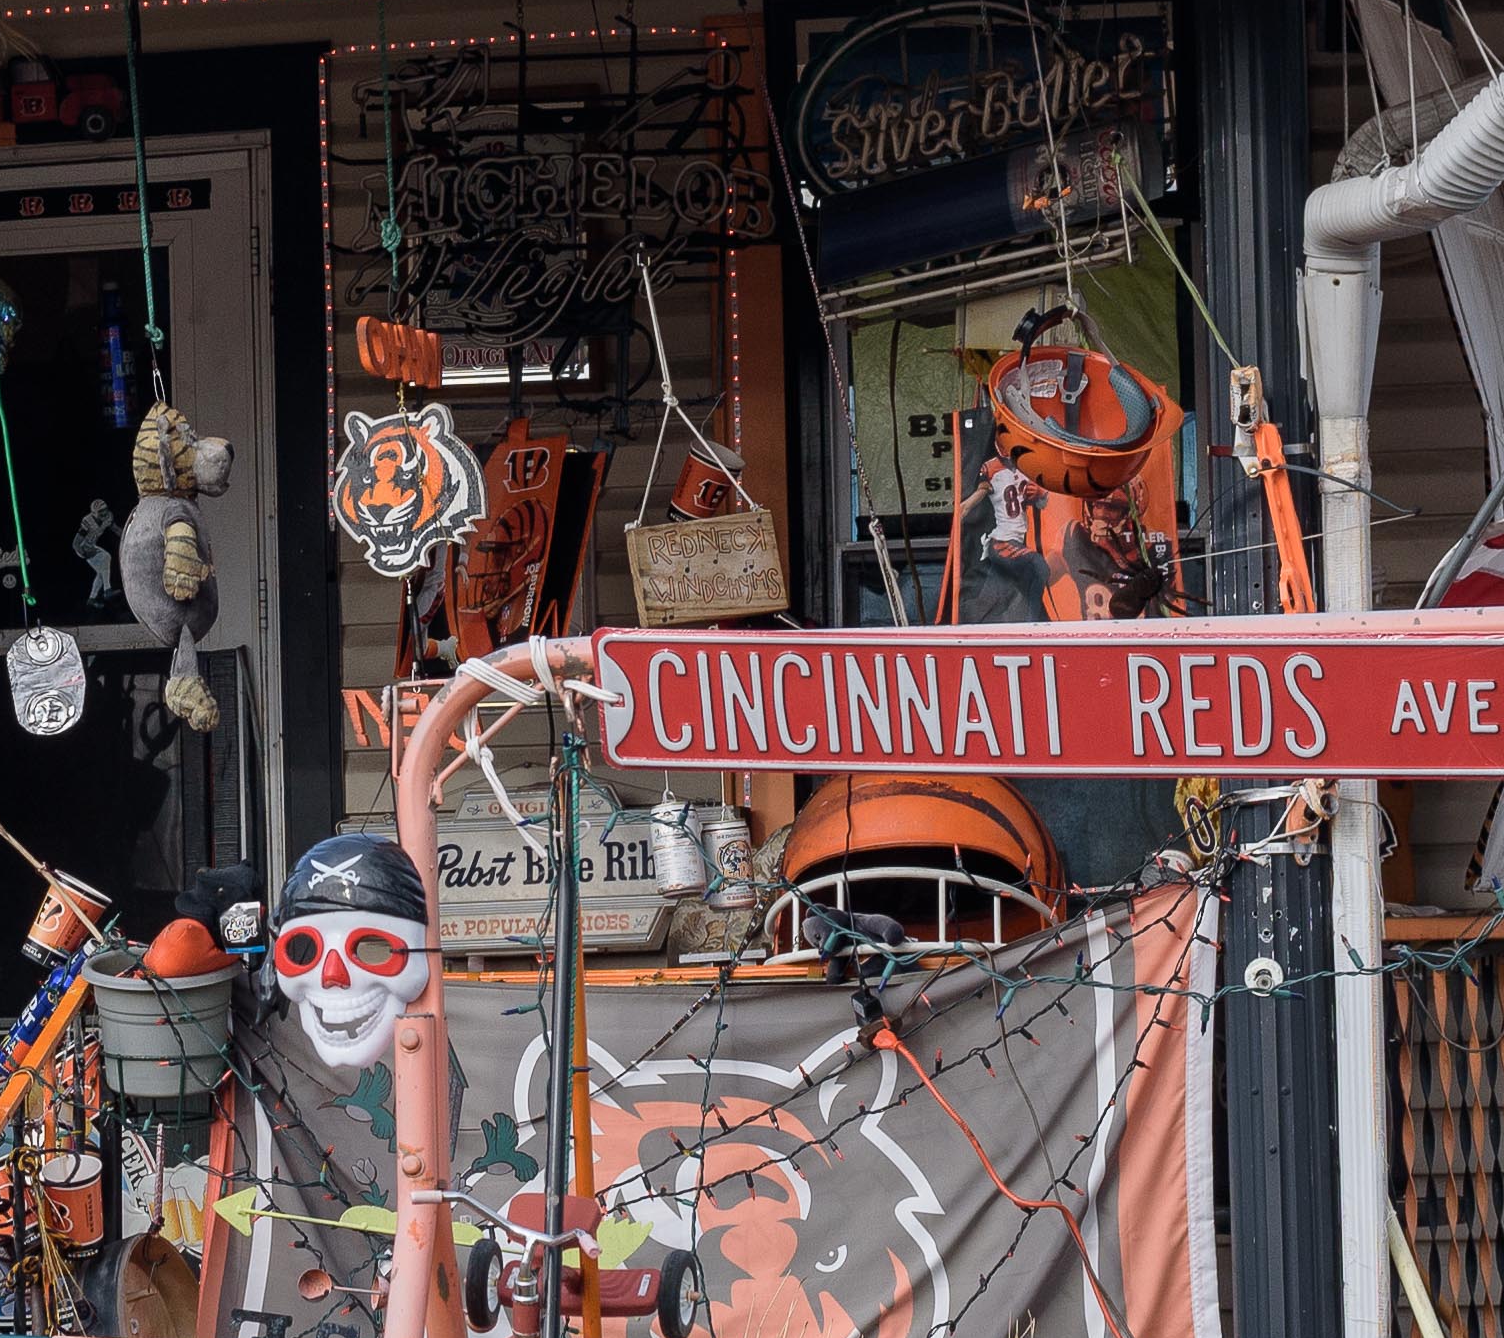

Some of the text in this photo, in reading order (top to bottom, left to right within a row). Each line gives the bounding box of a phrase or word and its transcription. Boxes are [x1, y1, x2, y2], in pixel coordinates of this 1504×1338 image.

[647, 524, 768, 565] REDNECK
[1122, 531, 1165, 543] TLER
[649, 567, 782, 604] WINDCHYMS
[647, 650, 1501, 759] CINCINNATI REDS AVE
[437, 843, 517, 888] Pabst
[464, 918, 554, 936] POPULA
[577, 913, 631, 931] RICES
